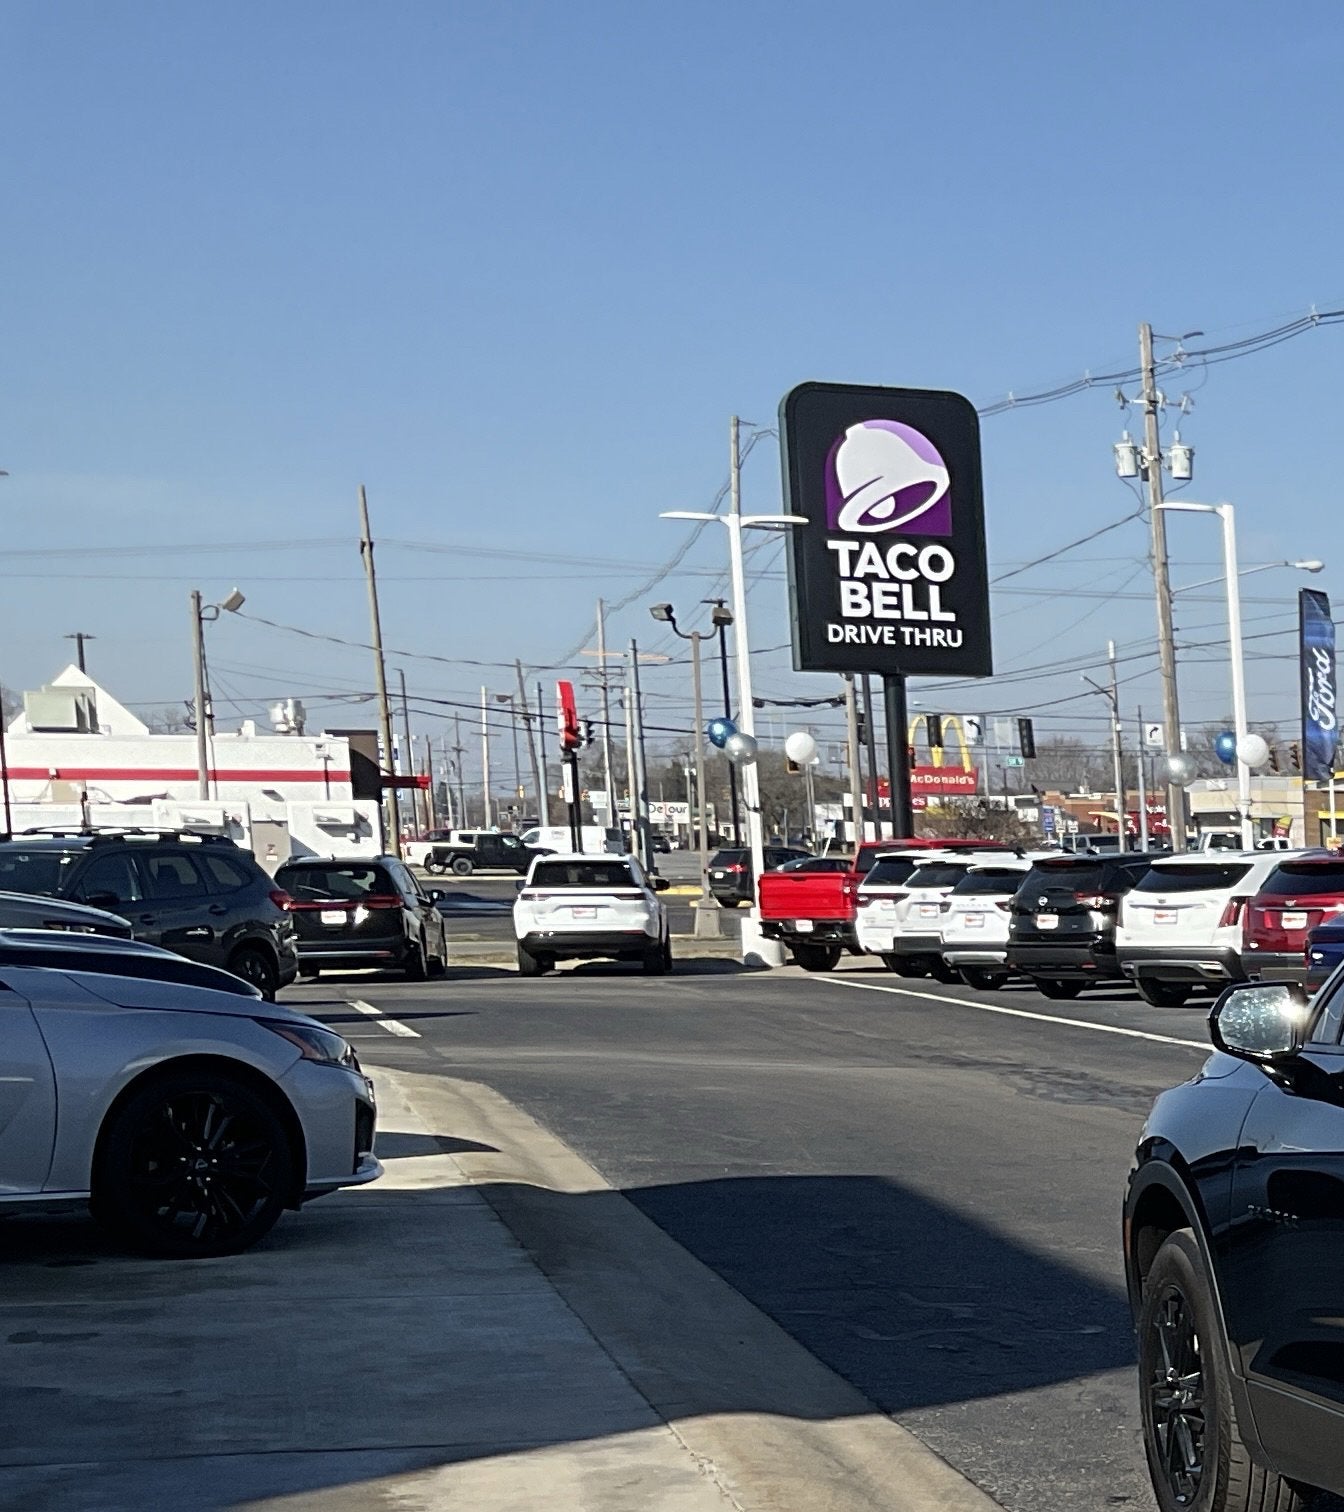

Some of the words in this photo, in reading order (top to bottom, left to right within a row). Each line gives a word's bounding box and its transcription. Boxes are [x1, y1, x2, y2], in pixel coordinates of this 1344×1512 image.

[826, 540, 955, 582] TACO
[840, 580, 956, 622] BELL
[827, 623, 896, 645] DRIVE
[900, 626, 963, 648] THRU
[1307, 647, 1336, 731] Ford
